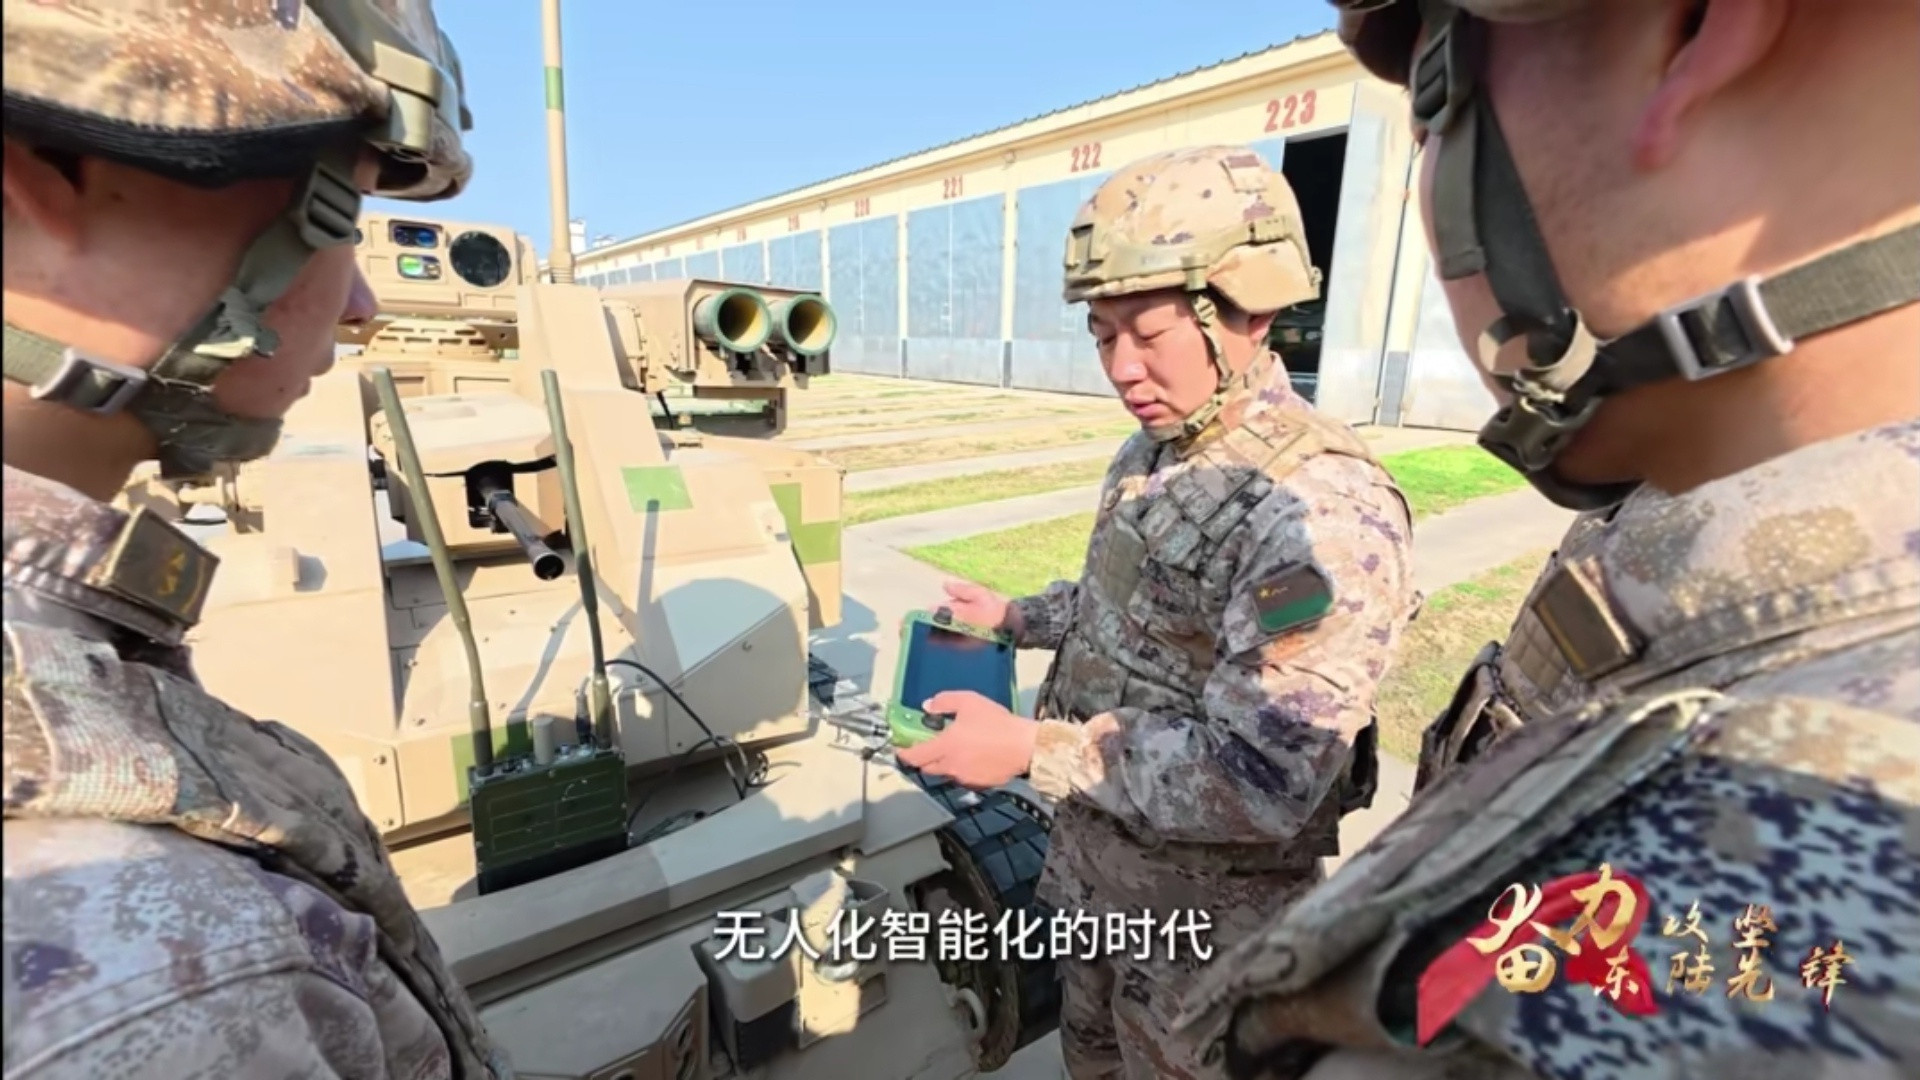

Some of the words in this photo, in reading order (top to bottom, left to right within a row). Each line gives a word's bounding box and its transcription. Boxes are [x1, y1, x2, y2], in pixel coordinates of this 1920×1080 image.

[1264, 89, 1317, 133] 223
[1070, 142, 1102, 173] 222
[943, 175, 963, 200] 221
